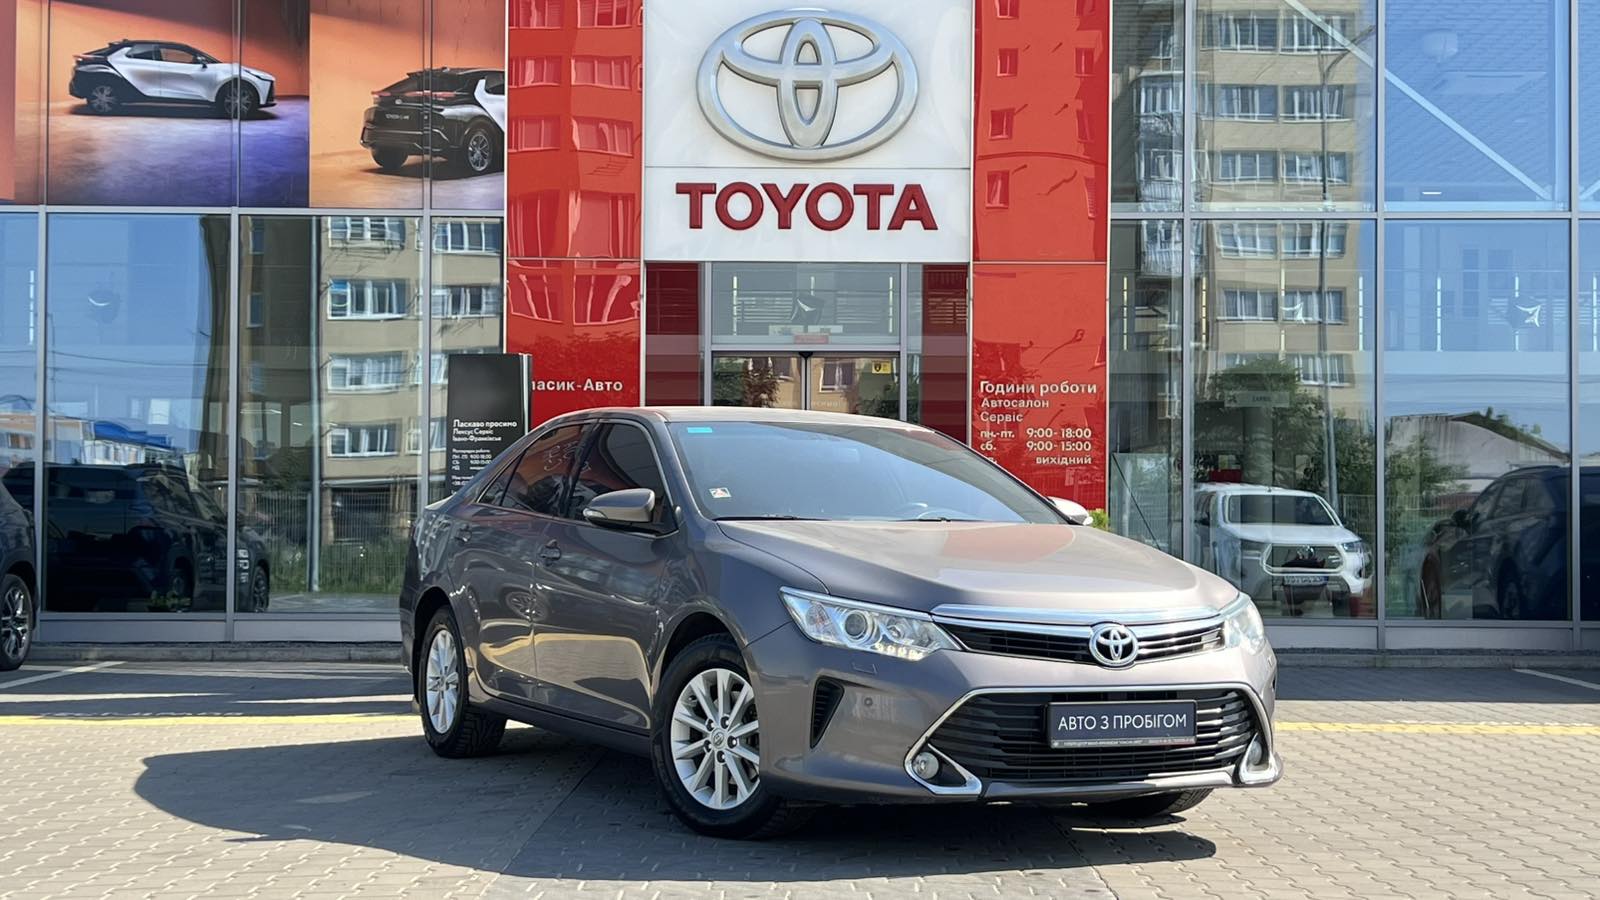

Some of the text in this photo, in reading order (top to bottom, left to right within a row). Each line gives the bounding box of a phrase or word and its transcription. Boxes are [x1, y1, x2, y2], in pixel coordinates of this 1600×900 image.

[675, 182, 938, 231] TOYOTA
[980, 380, 1097, 397] Години роботи
[981, 398, 1049, 408] Автосалон
[980, 411, 1023, 424] Сервіс
[1036, 455, 1092, 466] вихідний
[1058, 716, 1097, 731] АВТО
[1113, 714, 1187, 729] ПРОБІГОМ
